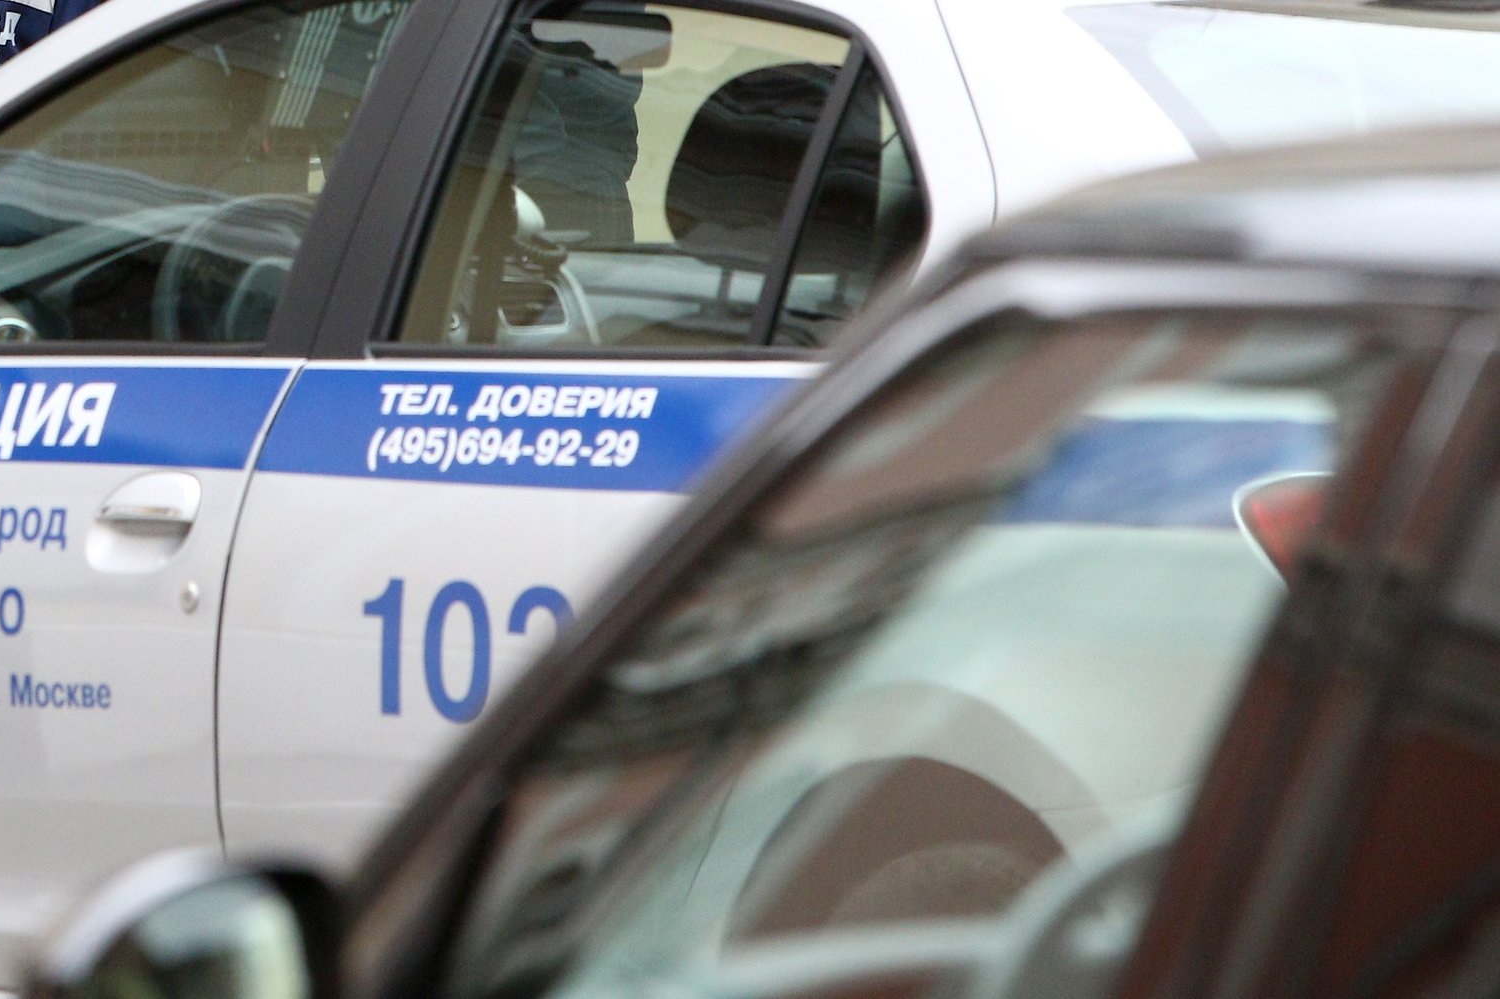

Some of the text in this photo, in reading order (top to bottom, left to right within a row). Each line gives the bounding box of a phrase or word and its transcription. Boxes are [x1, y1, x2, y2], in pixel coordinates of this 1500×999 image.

[380, 384, 659, 423] ТЕЛ. ДОВЕРИЯ
[367, 426, 640, 473] (495)694-92-29
[10, 675, 112, 710] Москве
